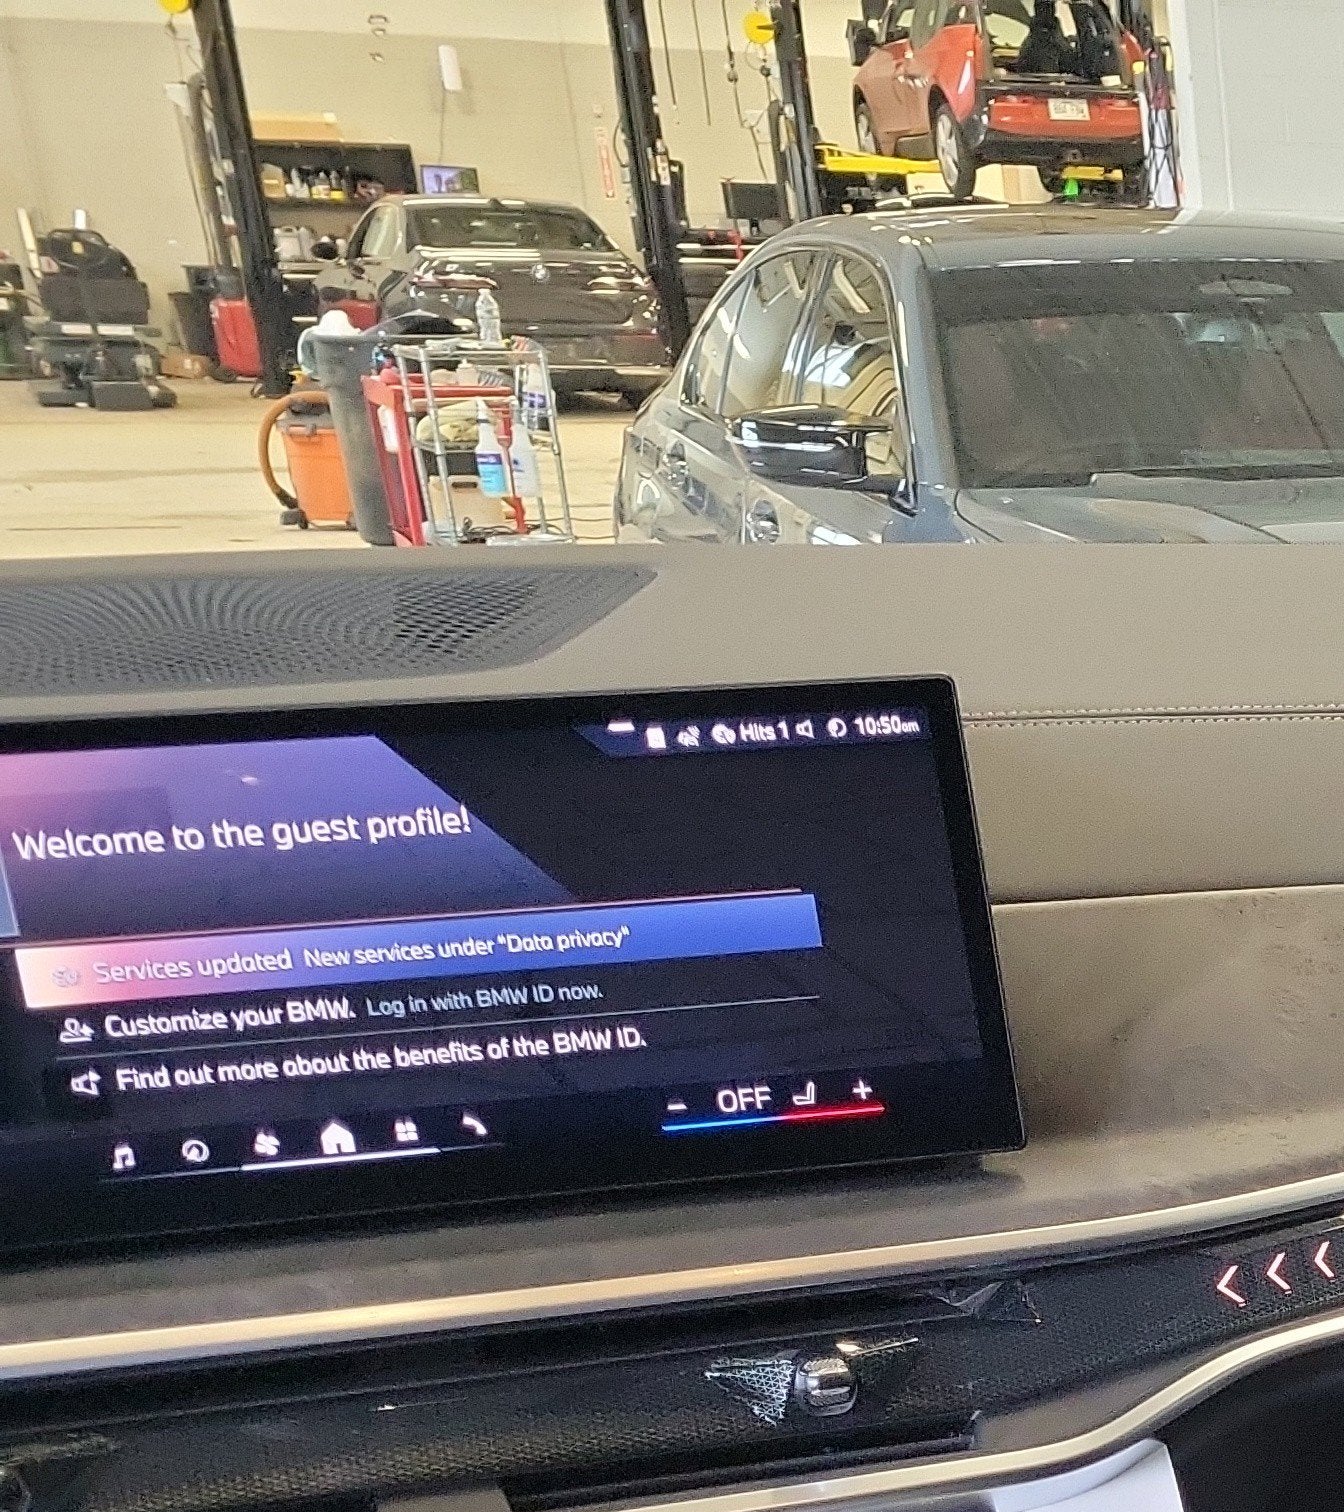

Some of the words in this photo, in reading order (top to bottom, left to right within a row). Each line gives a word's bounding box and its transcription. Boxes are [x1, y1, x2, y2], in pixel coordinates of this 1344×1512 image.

[739, 722, 777, 742] Hits
[12, 828, 166, 861] Welcome
[172, 825, 206, 852] to
[211, 819, 266, 850] the
[272, 814, 361, 853] guest
[367, 805, 473, 845] profile!
[94, 958, 193, 984] Services
[196, 947, 293, 978] updated
[303, 948, 350, 967] New
[353, 942, 436, 964] services
[437, 937, 495, 958] under
[104, 1008, 228, 1038] Customize
[230, 1007, 283, 1032] your
[286, 996, 356, 1023] BMW.
[366, 998, 406, 1018] Log
[408, 995, 428, 1013] in
[430, 991, 474, 1011] with
[475, 986, 528, 1008] BMW
[532, 984, 555, 1003] ID
[558, 984, 604, 1001] now.
[116, 1065, 171, 1091] Find
[174, 1063, 216, 1086] out
[217, 1061, 279, 1082] more
[282, 1052, 351, 1077] about
[352, 1048, 392, 1071] the
[393, 1041, 484, 1068] benefits
[486, 1036, 516, 1060] of
[513, 1035, 550, 1057] the
[552, 1028, 612, 1054] BMW
[616, 1026, 647, 1048] ID.
[717, 1086, 772, 1113] OFF
